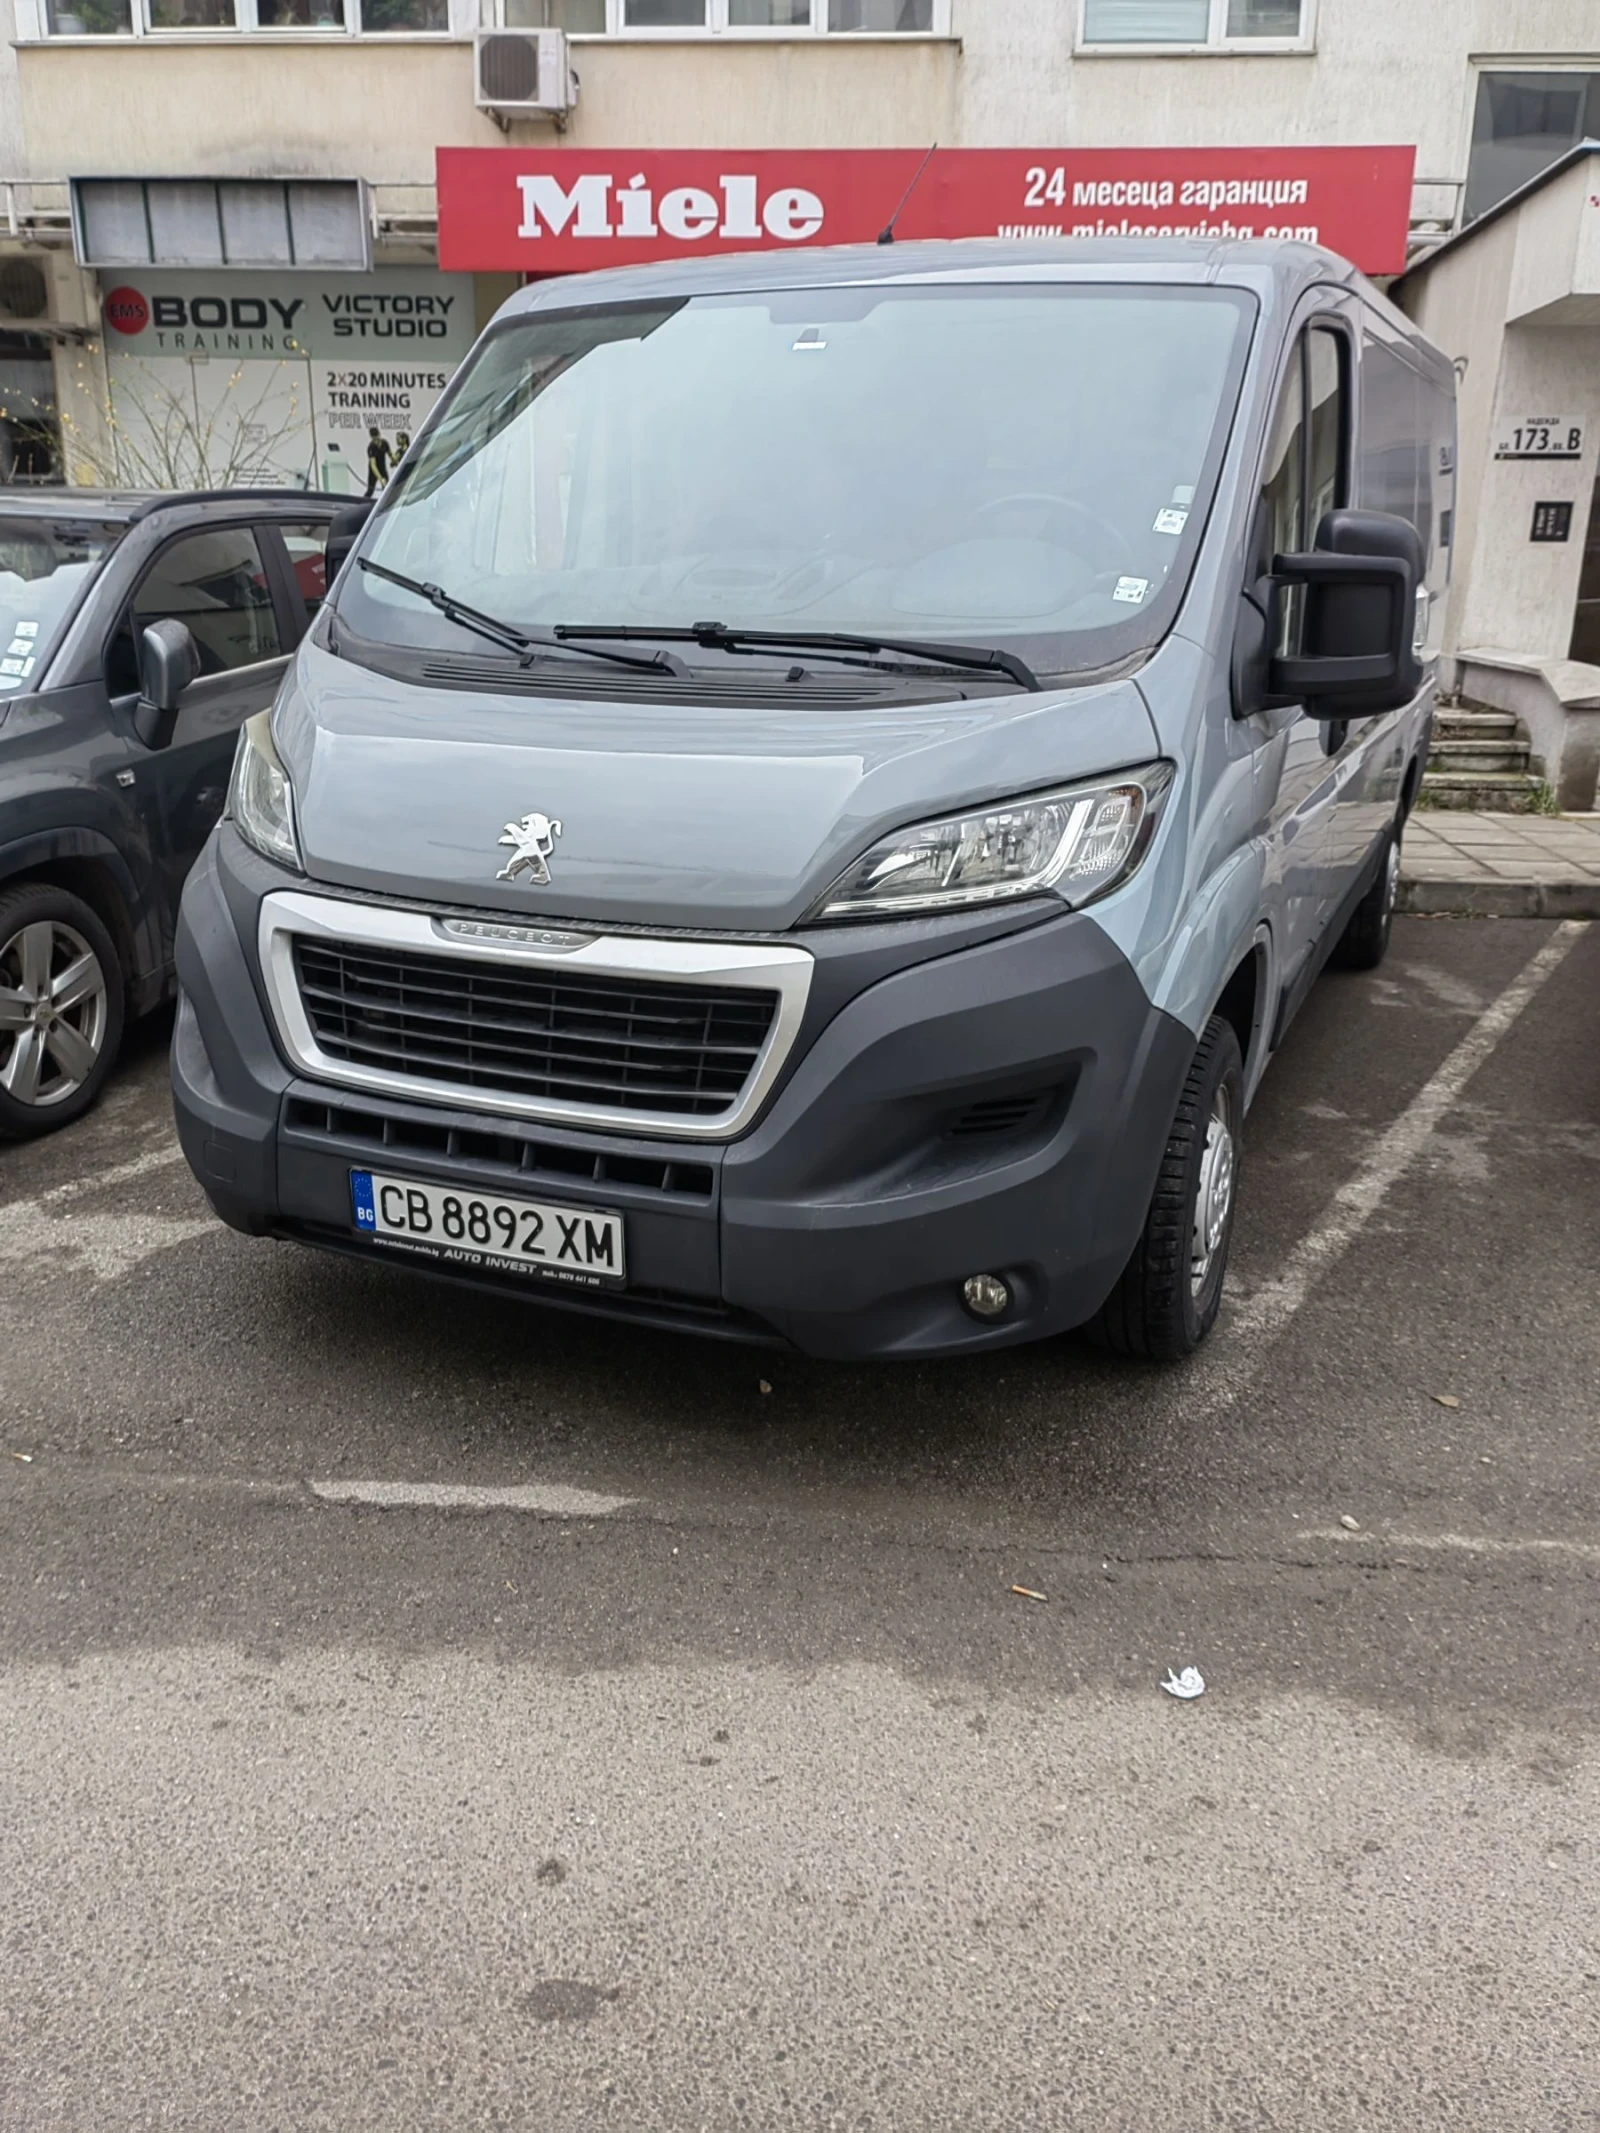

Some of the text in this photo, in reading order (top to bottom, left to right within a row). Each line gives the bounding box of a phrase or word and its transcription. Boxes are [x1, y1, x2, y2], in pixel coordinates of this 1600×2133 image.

[1024, 166, 1308, 211] 24 месеца гаранция
[516, 172, 824, 240] Miele
[109, 296, 303, 329] EMS BODY
[321, 293, 455, 315] VICTORY
[333, 317, 448, 338] STUDIO
[156, 332, 299, 351] TRAINING
[370, 372, 447, 389] MINUTES
[328, 391, 411, 409] TRAINING
[328, 411, 412, 430] PER WEEK
[357, 1206, 374, 1221] BG
[442, 1196, 547, 1256] 8892
[555, 1213, 615, 1268] XM
[444, 1249, 482, 1264] AUTO
[485, 1256, 537, 1274] INVEST
